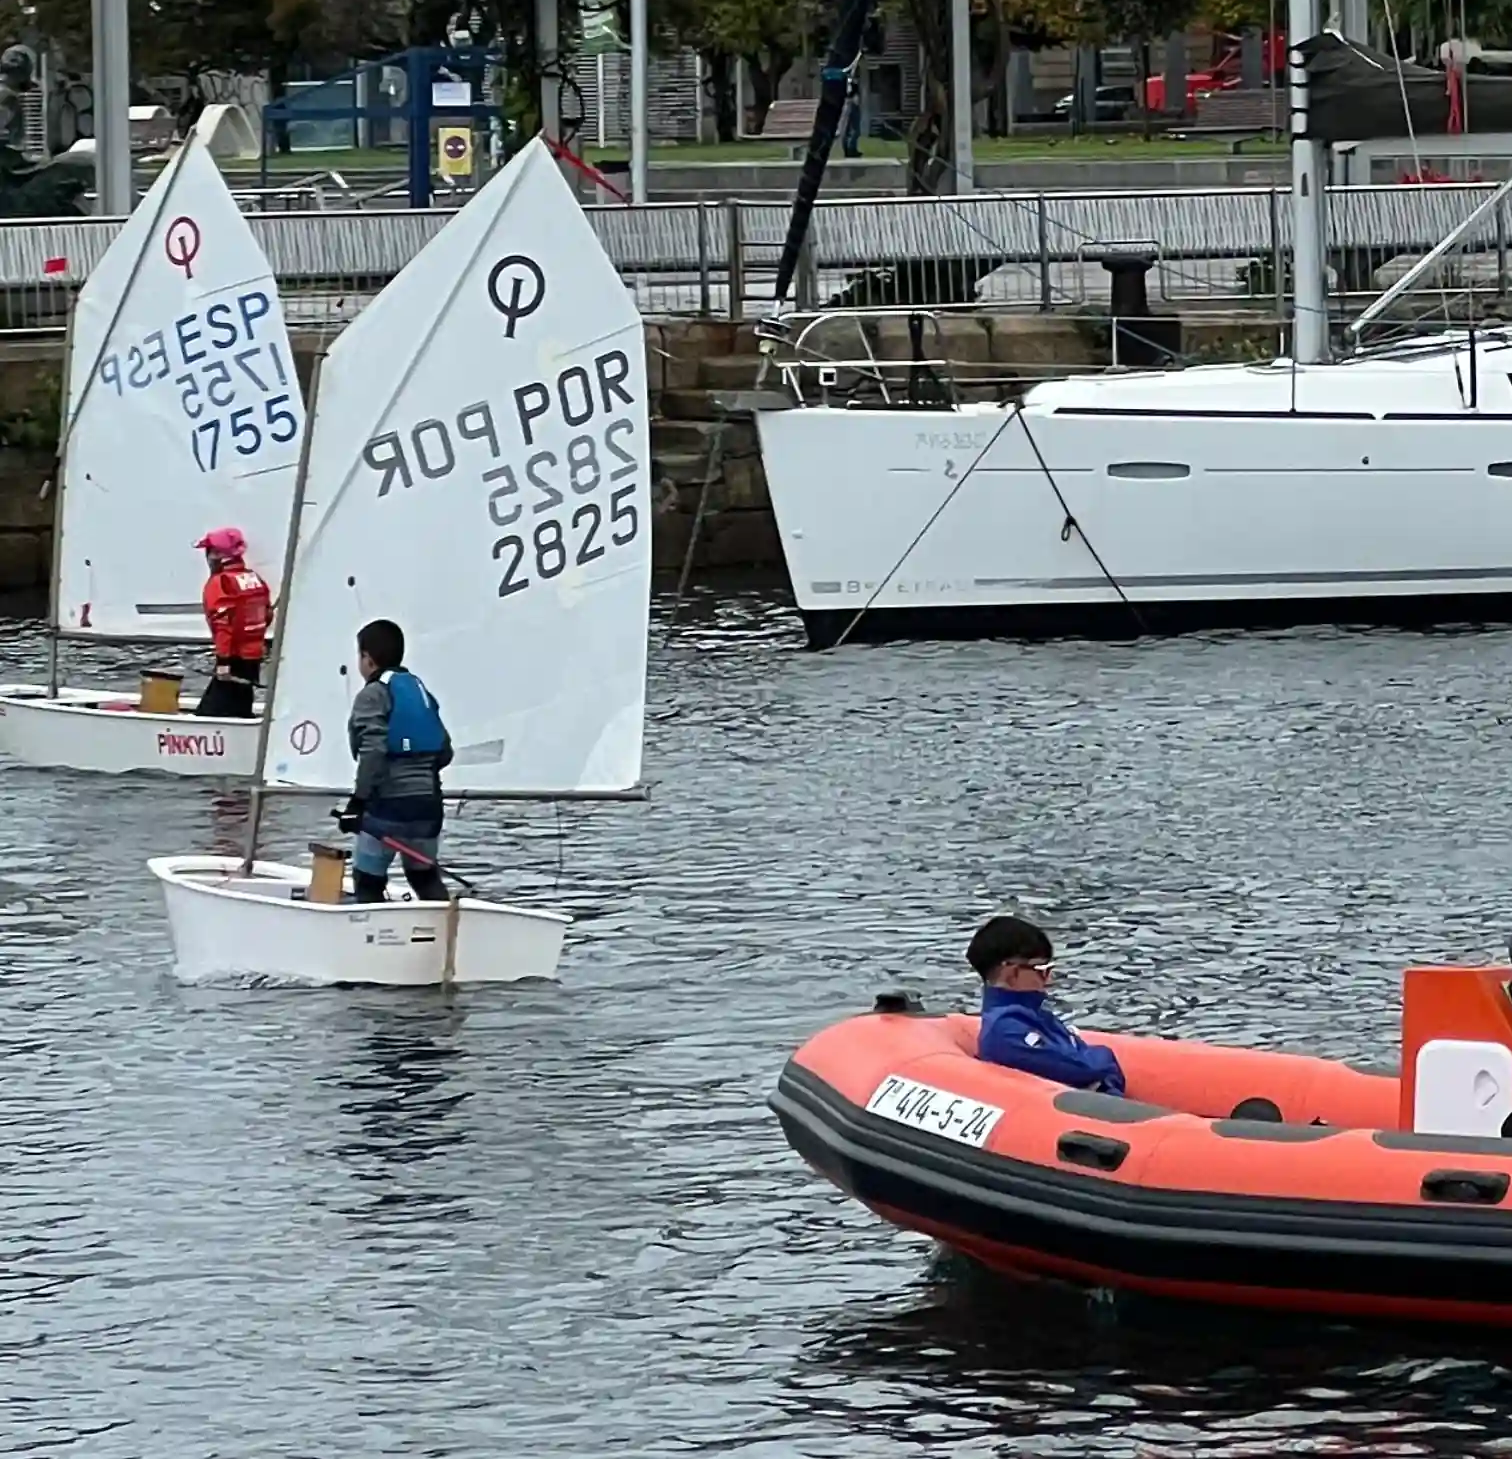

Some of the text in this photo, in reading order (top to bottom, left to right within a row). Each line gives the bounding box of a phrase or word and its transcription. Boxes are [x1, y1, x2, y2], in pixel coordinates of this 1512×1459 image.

[175, 292, 270, 364] ESP
[192, 394, 298, 473] 1755
[513, 350, 635, 445] POR
[492, 483, 638, 598] 2825
